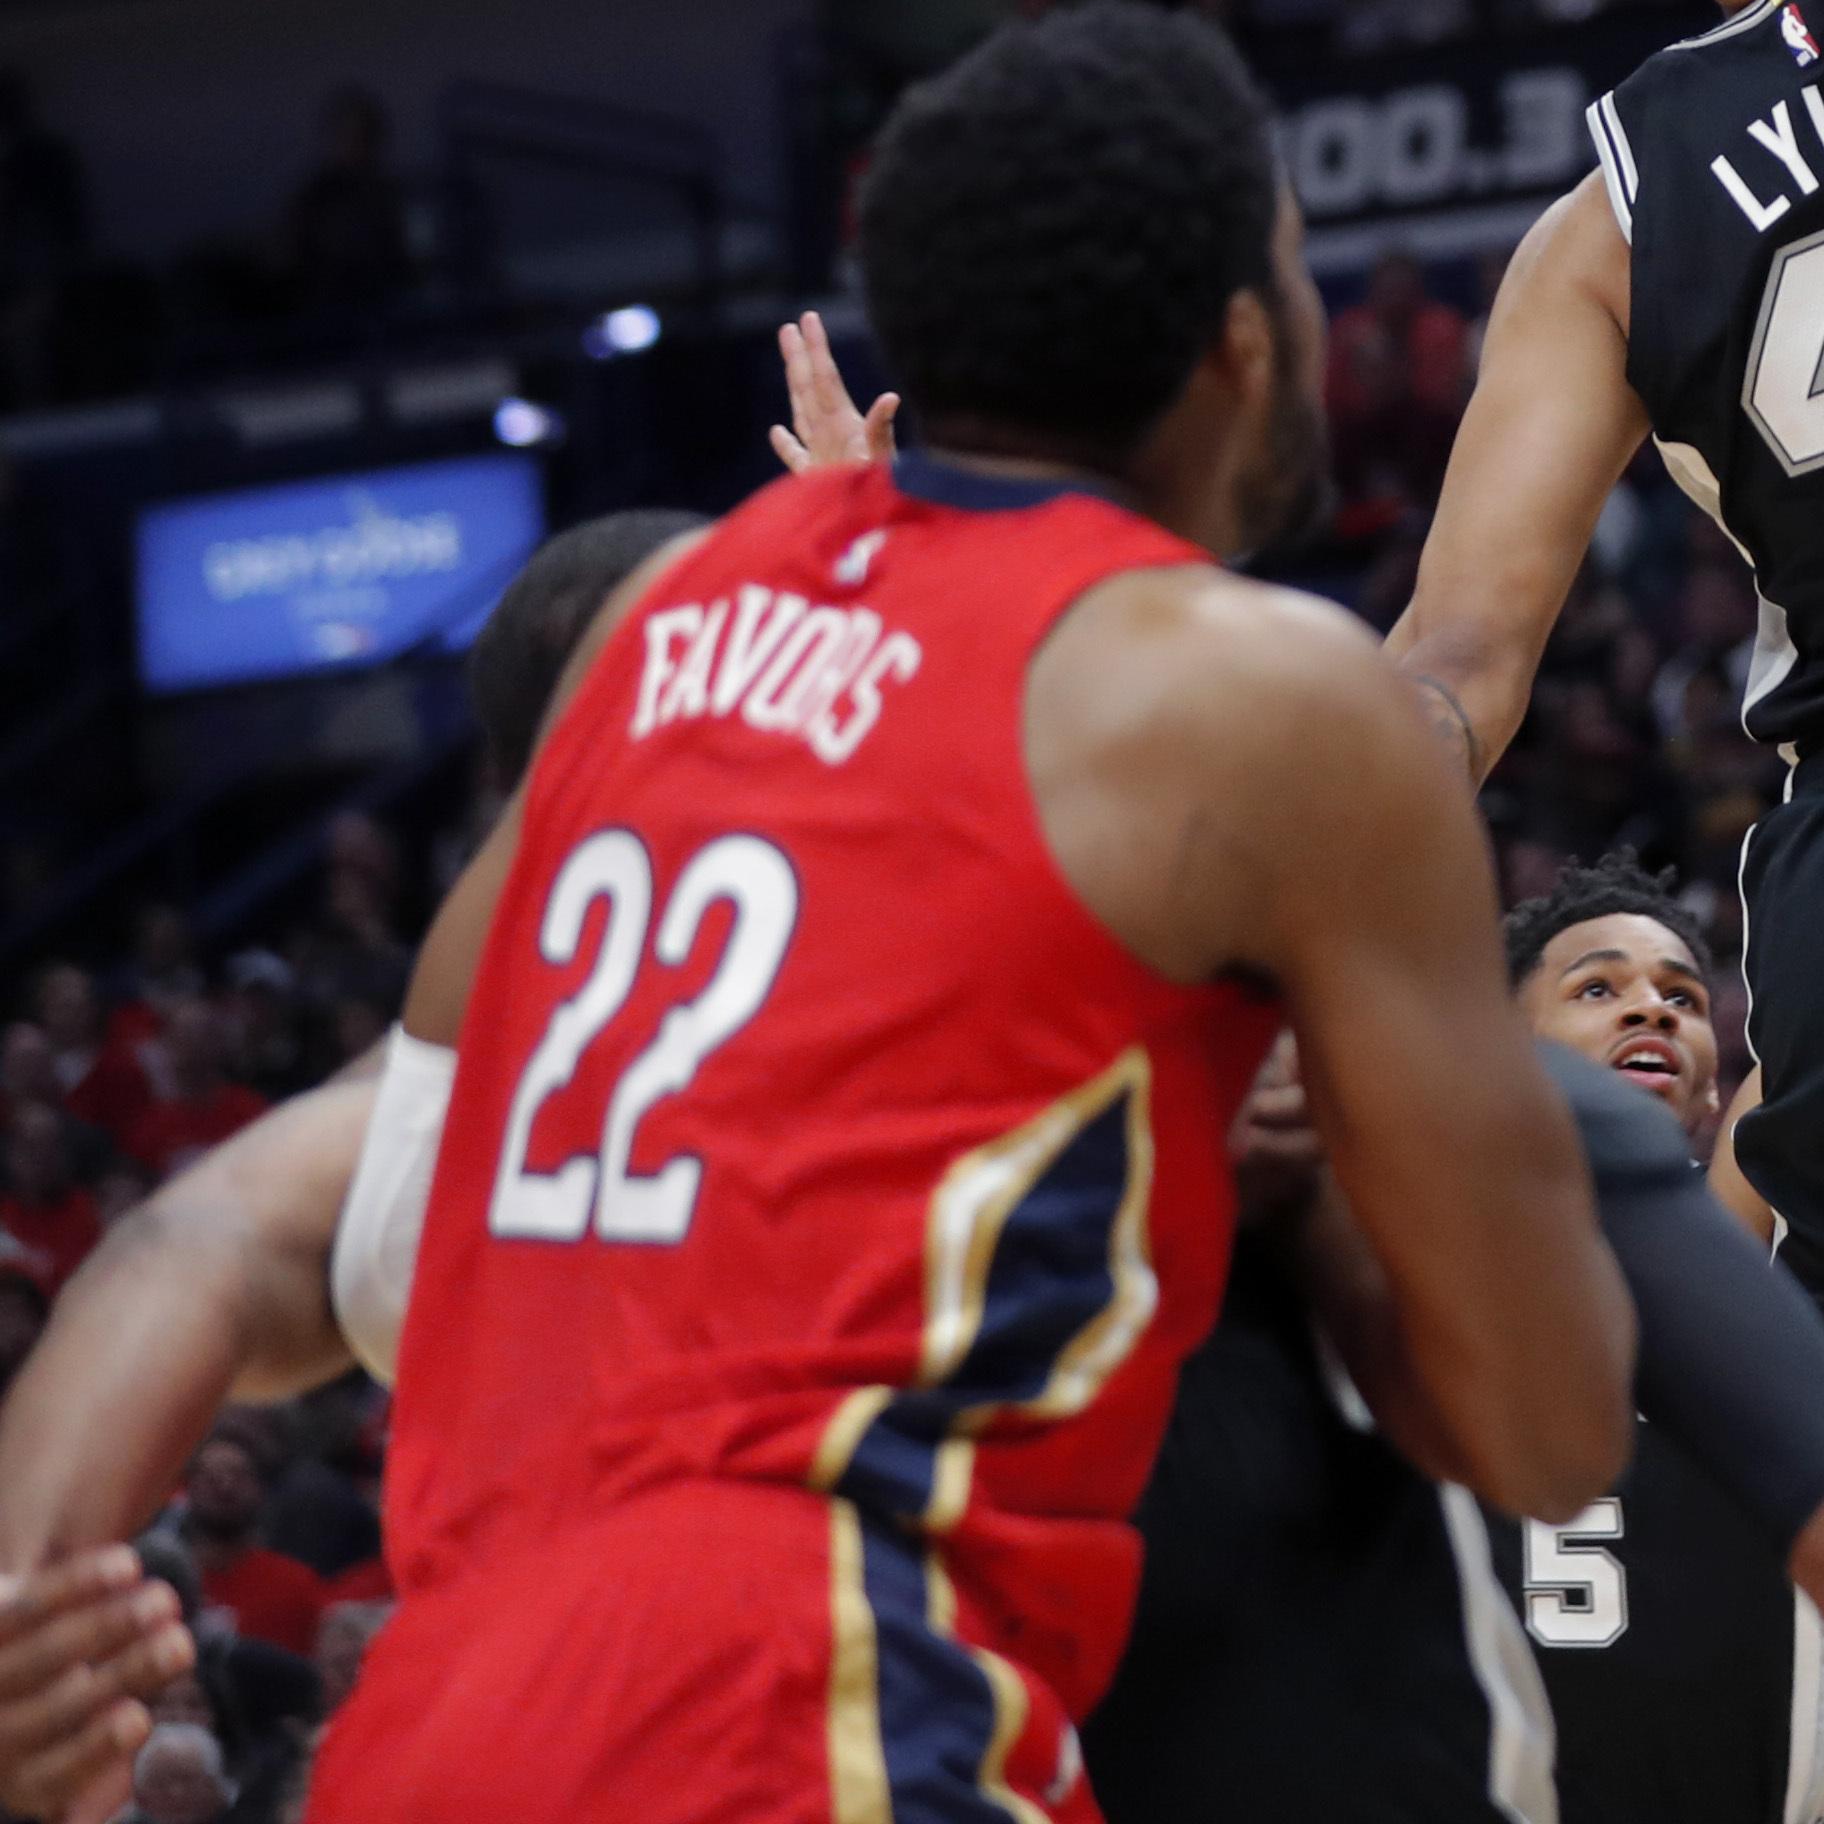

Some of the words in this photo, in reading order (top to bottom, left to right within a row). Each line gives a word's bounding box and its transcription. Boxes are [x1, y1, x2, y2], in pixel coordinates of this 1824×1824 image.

[630, 584, 922, 766] FAVORS
[488, 825, 802, 1246] 22
[1522, 1496, 1629, 1649] 5
